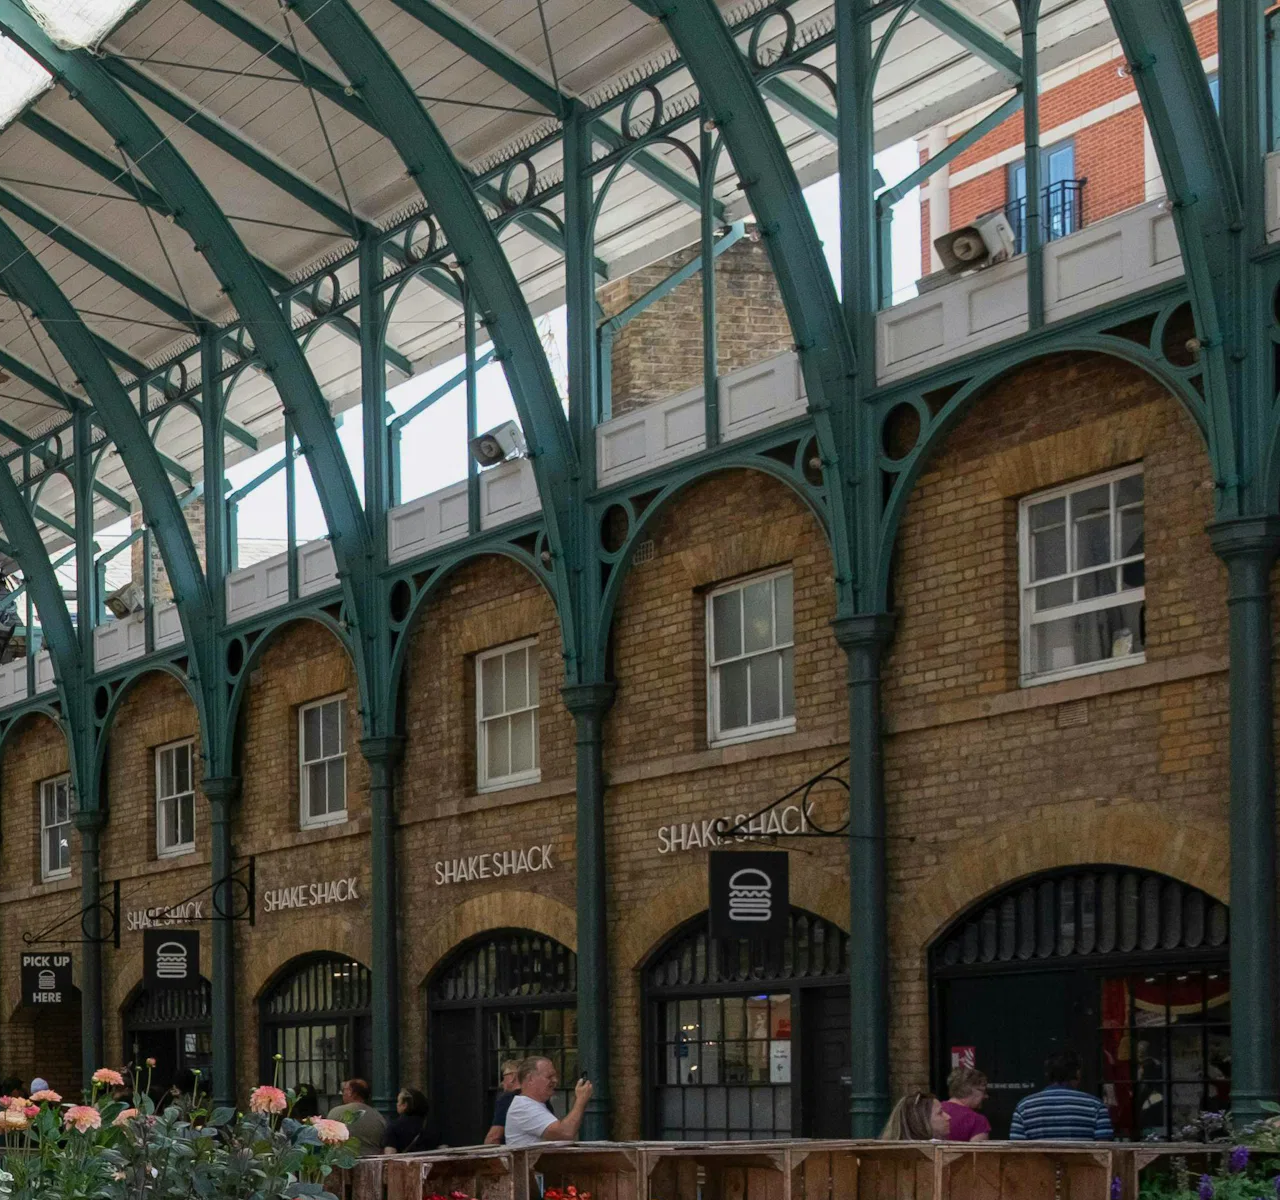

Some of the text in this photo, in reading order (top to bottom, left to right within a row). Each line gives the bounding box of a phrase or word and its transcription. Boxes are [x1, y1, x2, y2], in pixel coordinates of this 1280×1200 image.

[434, 844, 554, 886] SHAKE SHACK
[264, 877, 359, 912] SHAKE SHACK
[23, 956, 71, 967] PICK UP
[32, 992, 62, 1003] HERE
